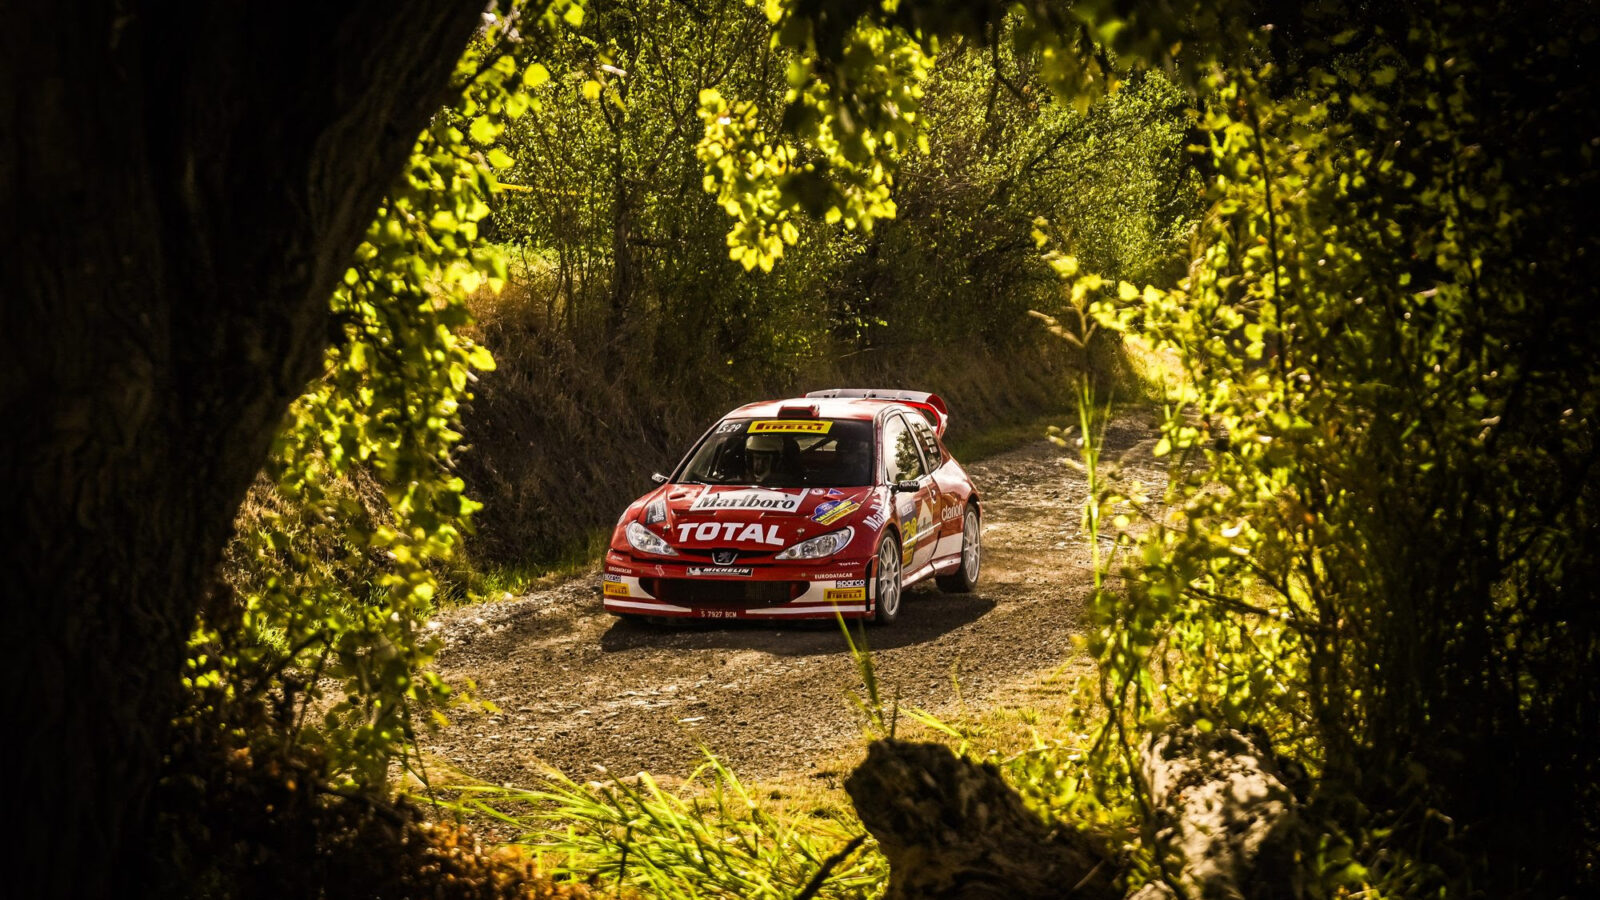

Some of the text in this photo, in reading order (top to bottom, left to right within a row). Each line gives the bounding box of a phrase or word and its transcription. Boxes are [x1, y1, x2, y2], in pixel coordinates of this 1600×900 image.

[755, 422, 825, 432] PIRELLI
[697, 494, 796, 509] Marlboro
[677, 522, 785, 546] TOTAL
[836, 580, 865, 588] sparco
[827, 590, 862, 599] PIRELLI
